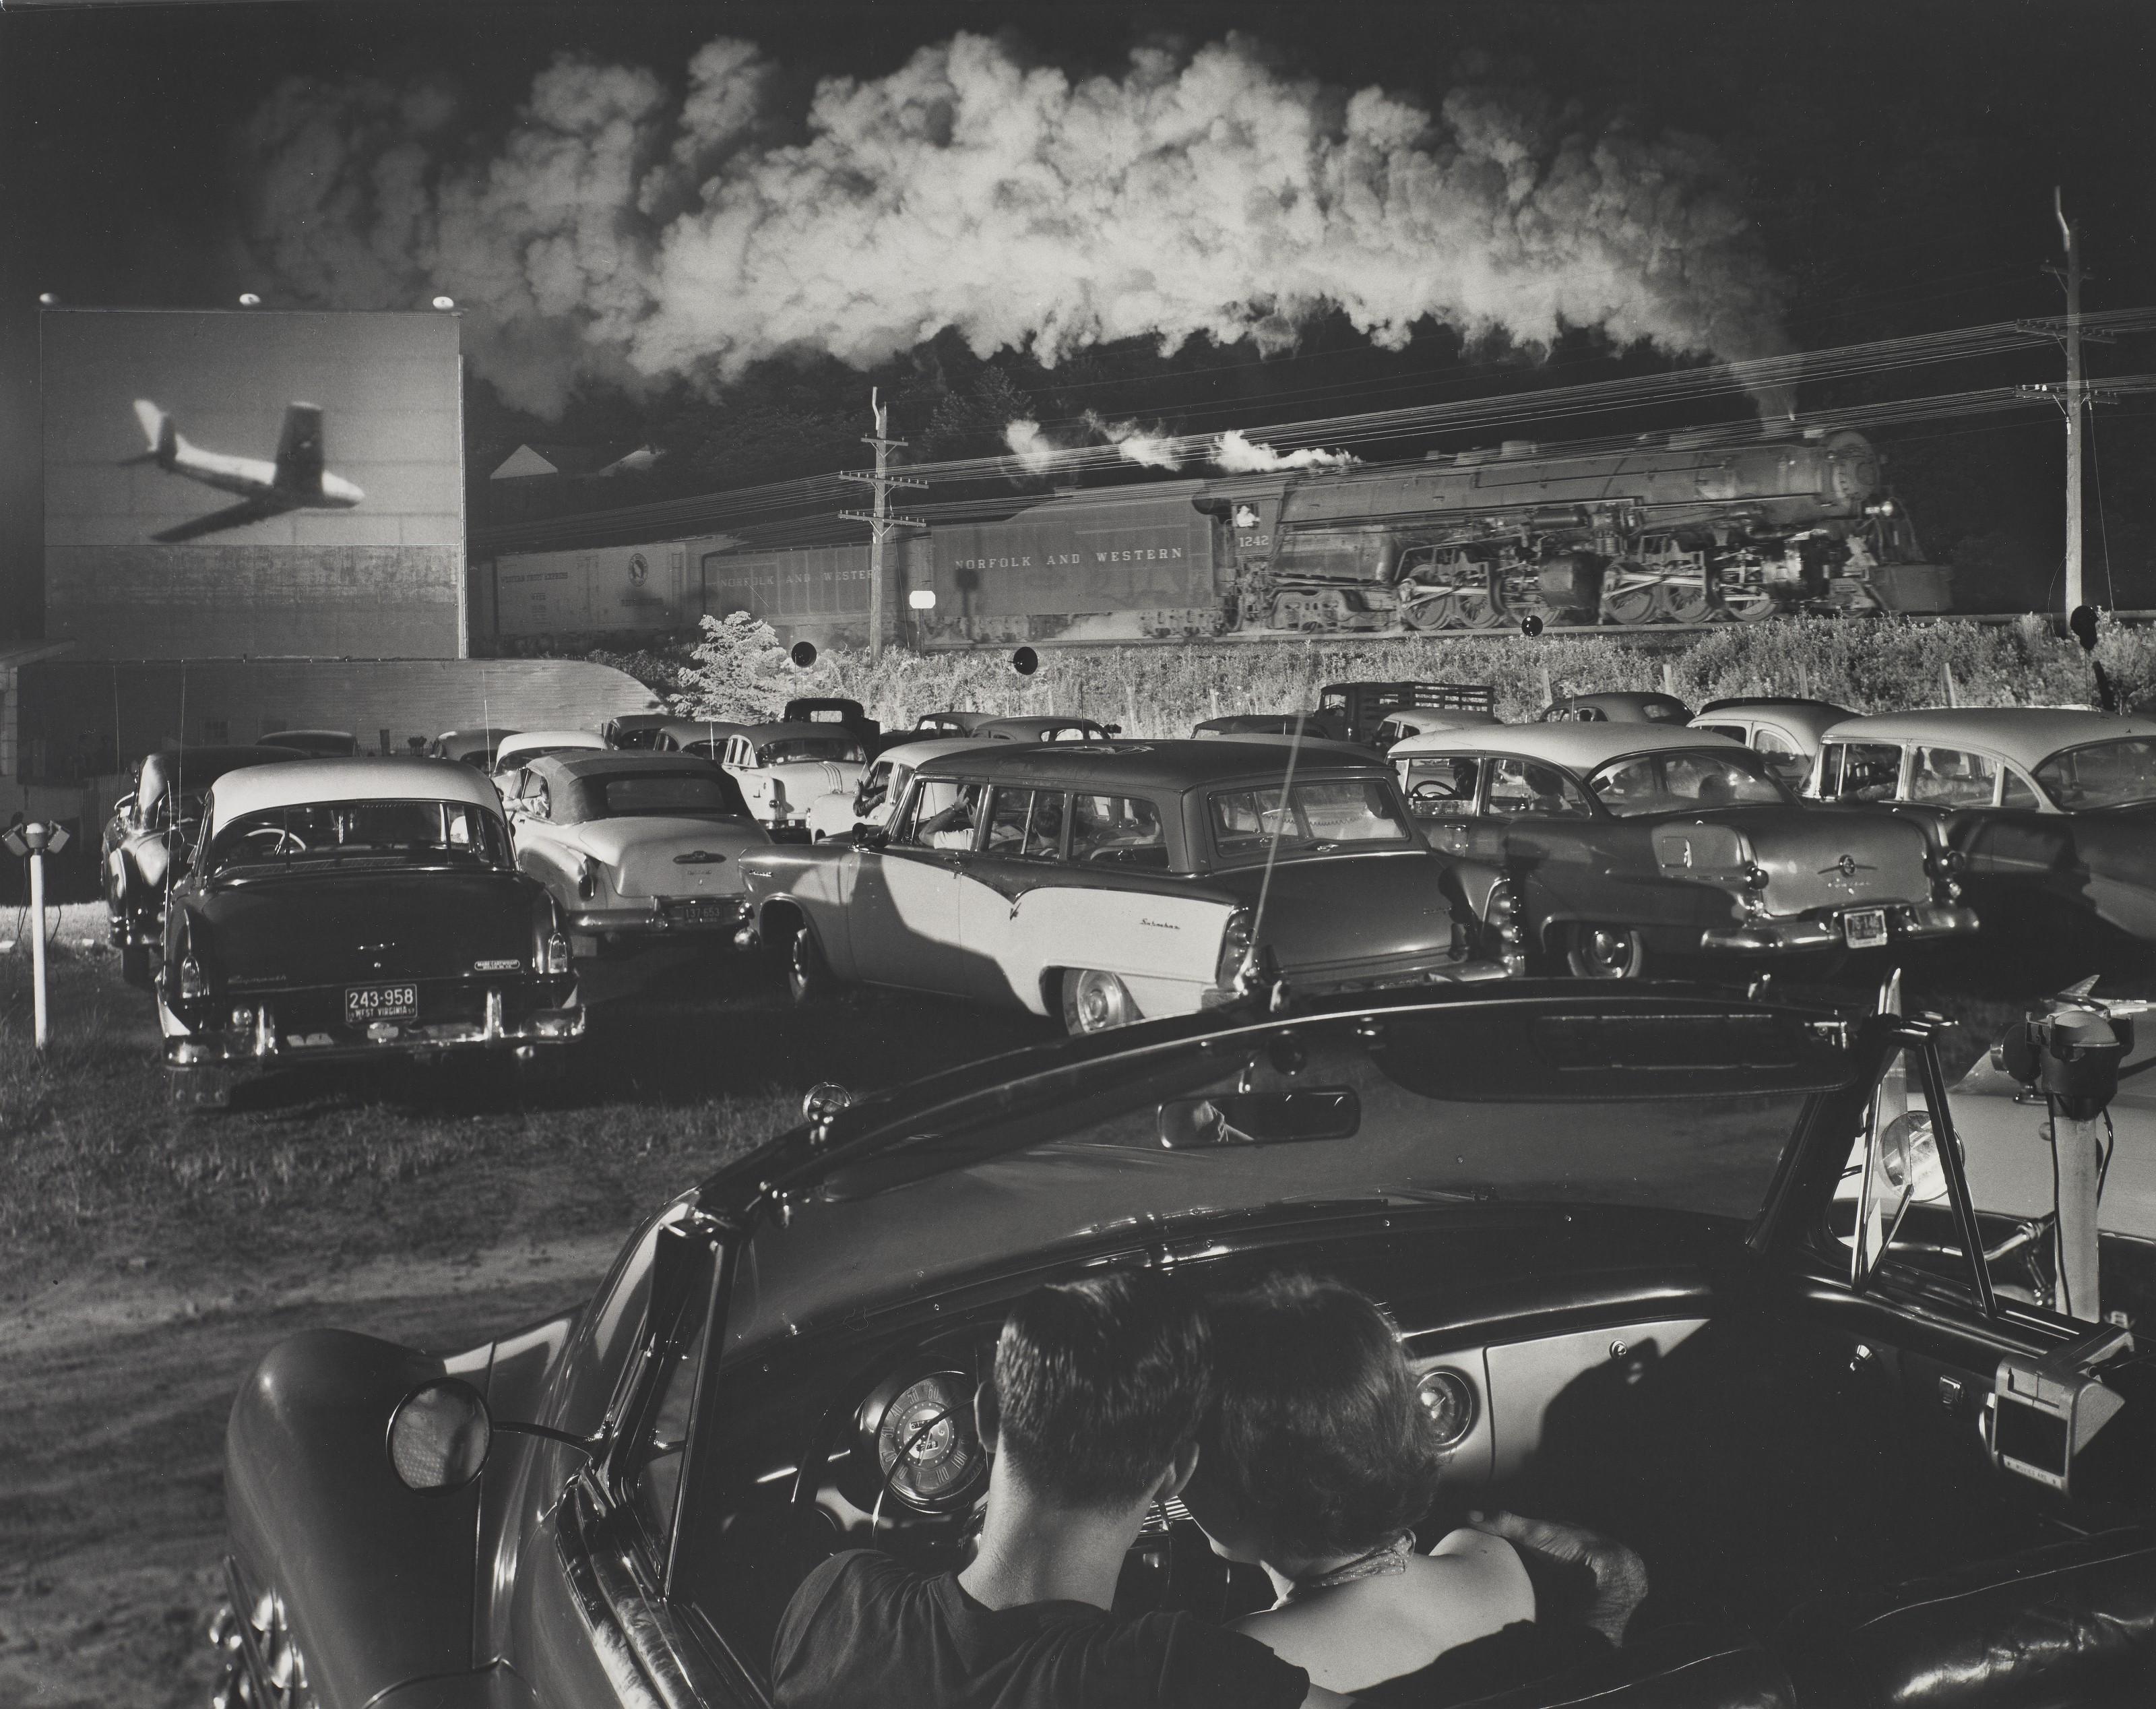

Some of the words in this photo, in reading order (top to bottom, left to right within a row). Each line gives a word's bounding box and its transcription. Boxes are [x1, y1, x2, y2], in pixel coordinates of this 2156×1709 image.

[1239, 535, 1269, 547] 1242
[955, 557, 1032, 569] NORFOLK
[1046, 554, 1080, 565] AND
[1096, 548, 1182, 562] WESTERN
[720, 576, 775, 587] NORFOLK
[786, 573, 811, 584] AND
[822, 569, 872, 582] WESTER
[355, 1008, 374, 1018] WEST
[377, 1006, 408, 1016] VIRGINIA
[951, 1450, 968, 1470] 100
